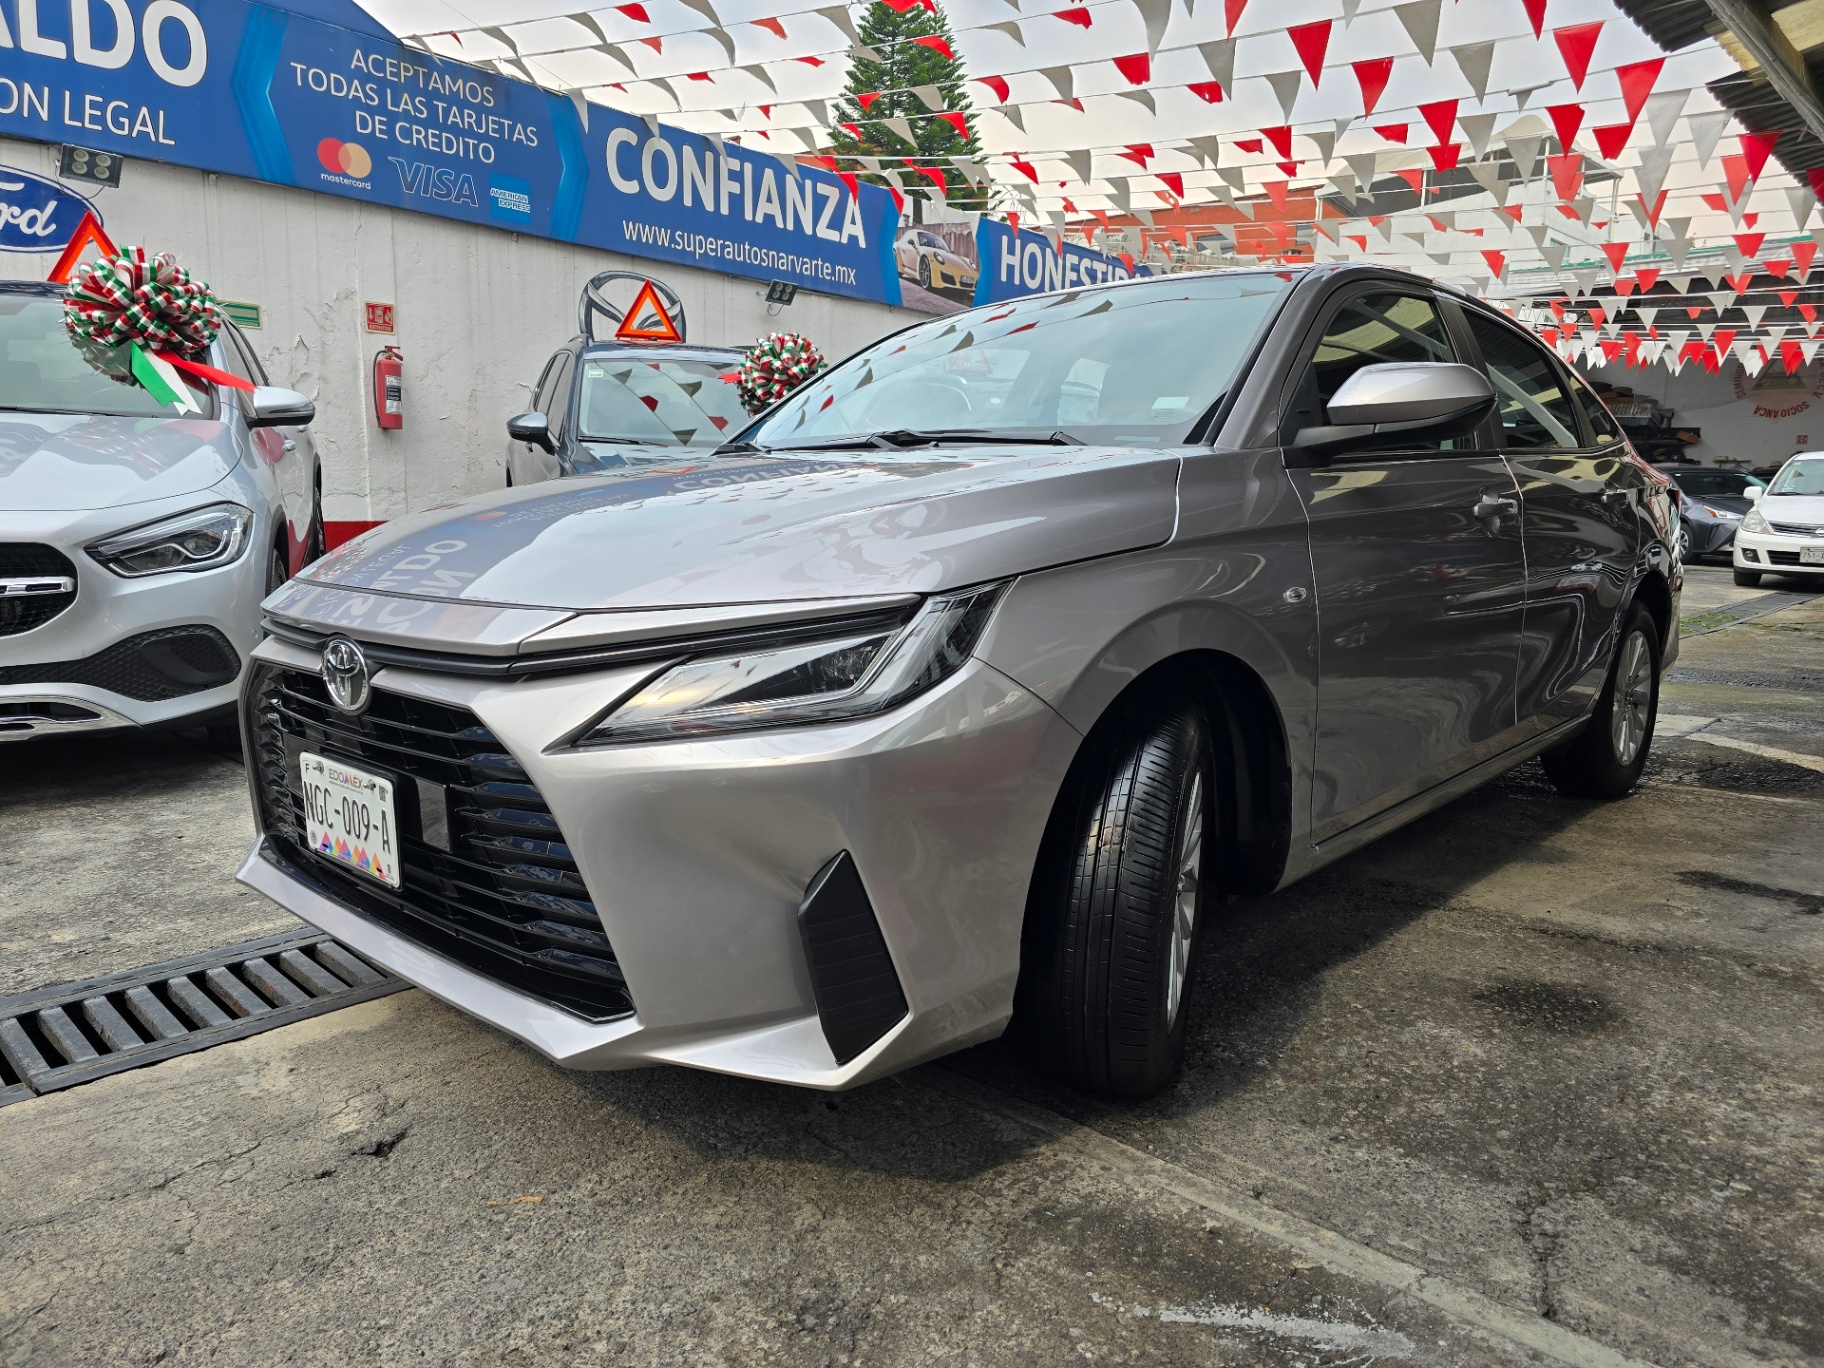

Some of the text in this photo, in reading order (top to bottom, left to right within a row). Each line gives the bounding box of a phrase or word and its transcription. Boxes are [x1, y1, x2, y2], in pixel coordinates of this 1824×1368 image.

[0, 0, 209, 88] LDO
[291, 61, 538, 147] TODAS LAS TARJETAS
[351, 49, 495, 107] ACEPTAMOS
[63, 89, 177, 146] LEGAL
[355, 110, 495, 164] DE CREDITO
[0, 182, 58, 237] rd
[320, 172, 371, 190] mastercard
[387, 156, 479, 207] VISA
[490, 187, 529, 204] AMERICAN
[498, 197, 531, 213] EXPRESS
[605, 126, 867, 249] CONFIANZA
[622, 219, 857, 286] www.superautosnarvarte.mx
[1001, 235, 1142, 293] HONEST
[303, 780, 391, 854] NGC-009-A
